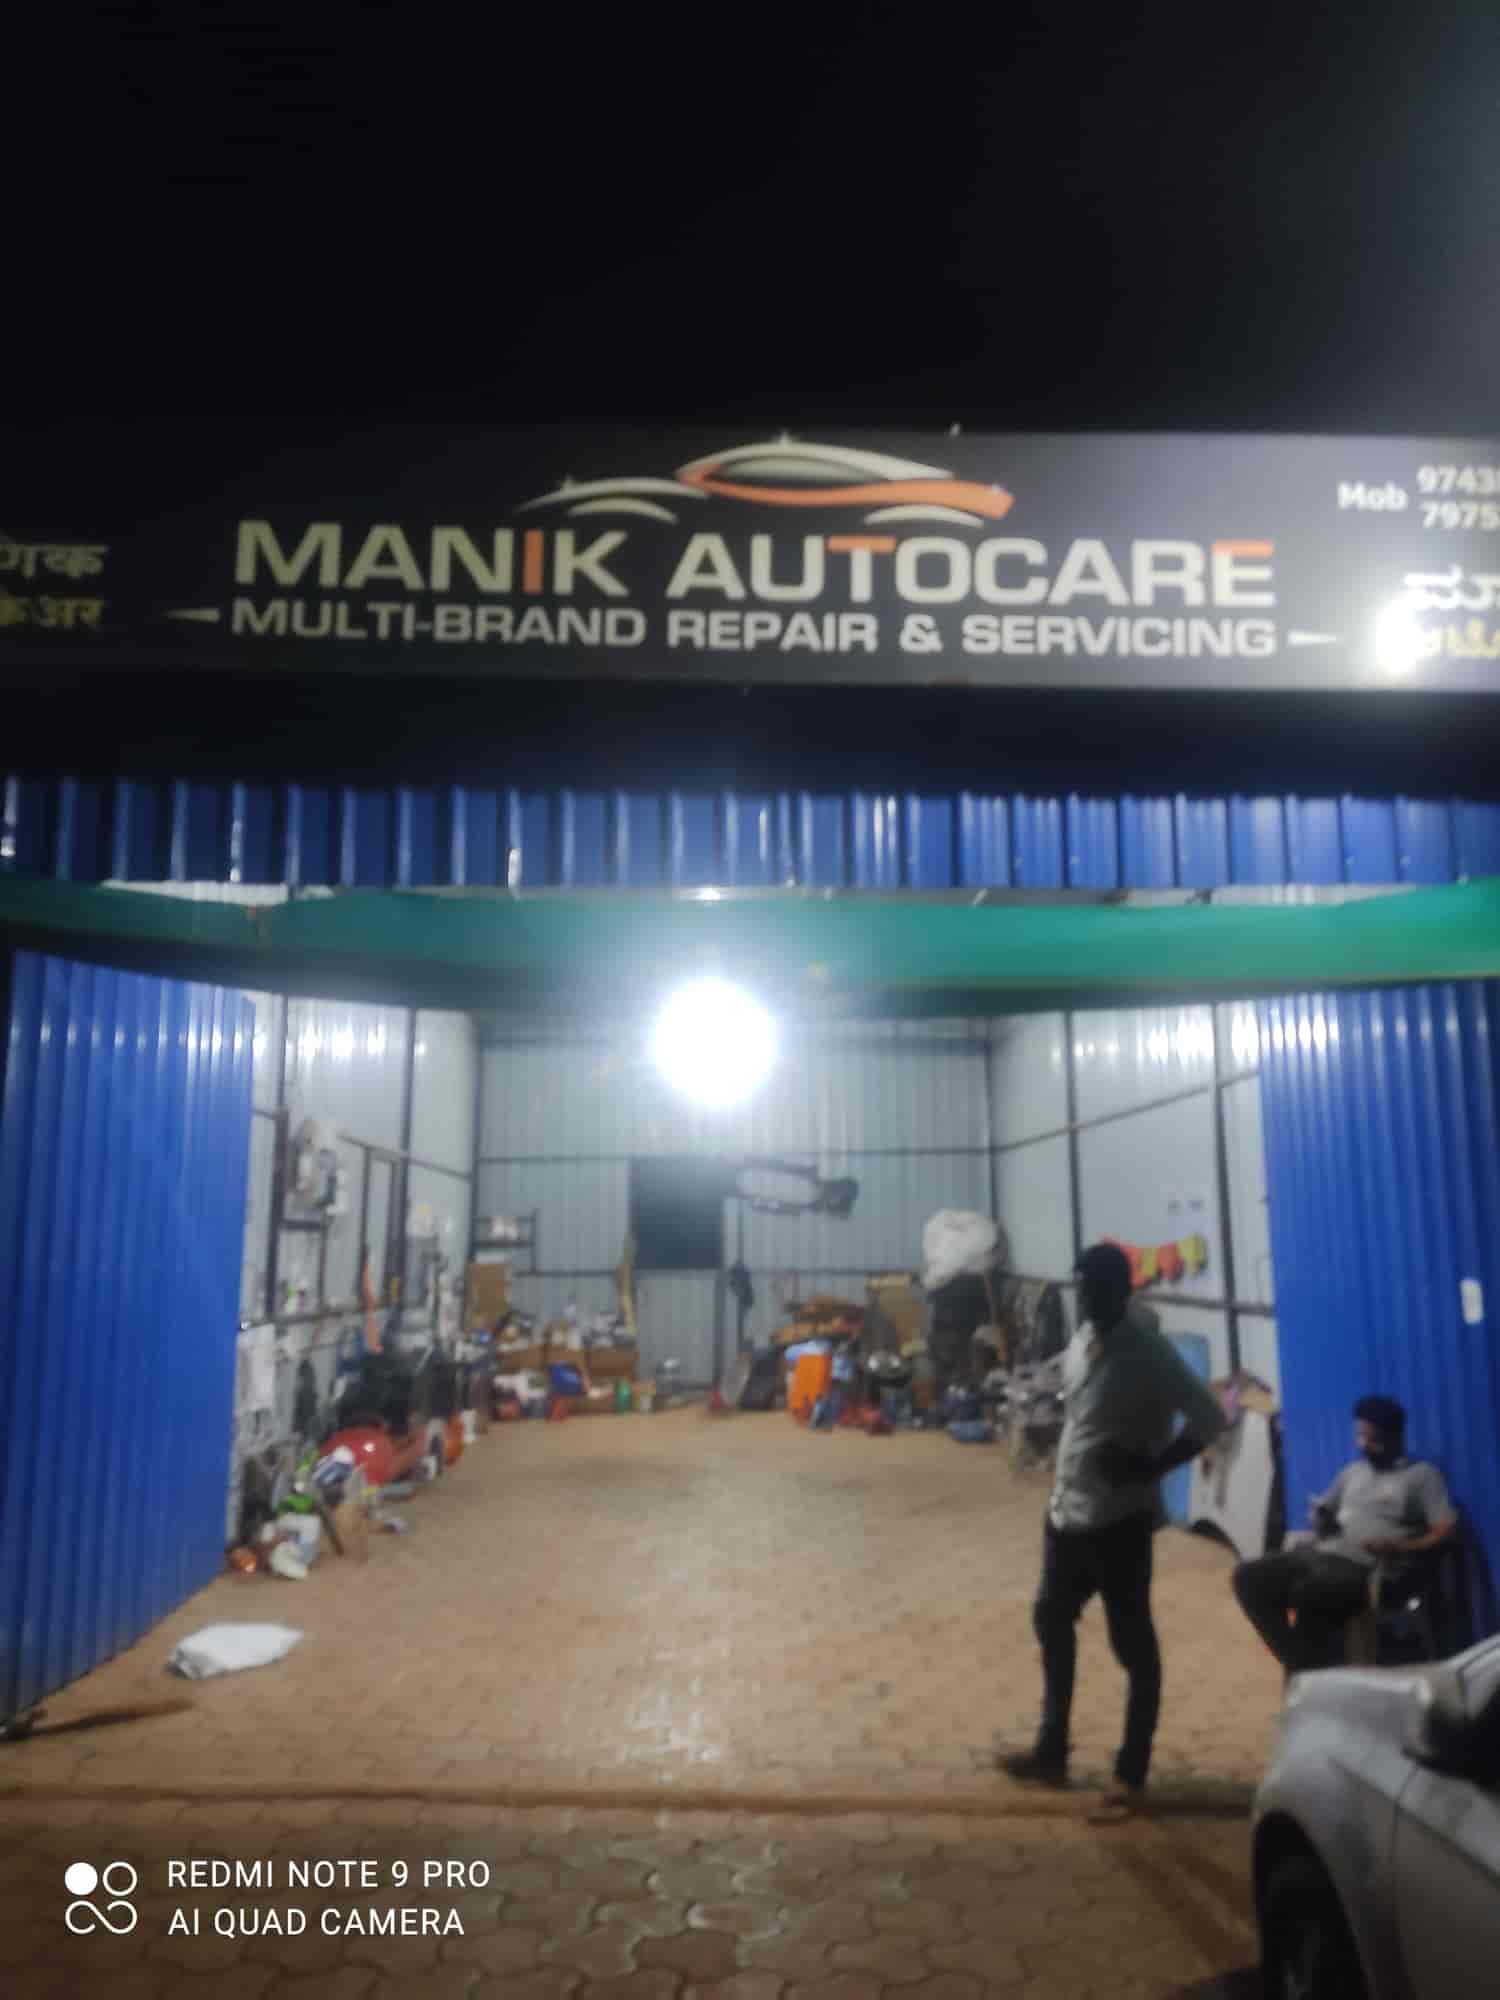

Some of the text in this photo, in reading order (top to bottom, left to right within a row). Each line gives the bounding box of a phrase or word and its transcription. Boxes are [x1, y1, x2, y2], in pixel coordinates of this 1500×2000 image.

[1337, 463, 1500, 511] Mob 9743
[234, 519, 1277, 608] MANIK AUTOCARE
[231, 597, 1277, 658] MULTI-BRAND REPAIR & SERVICING
